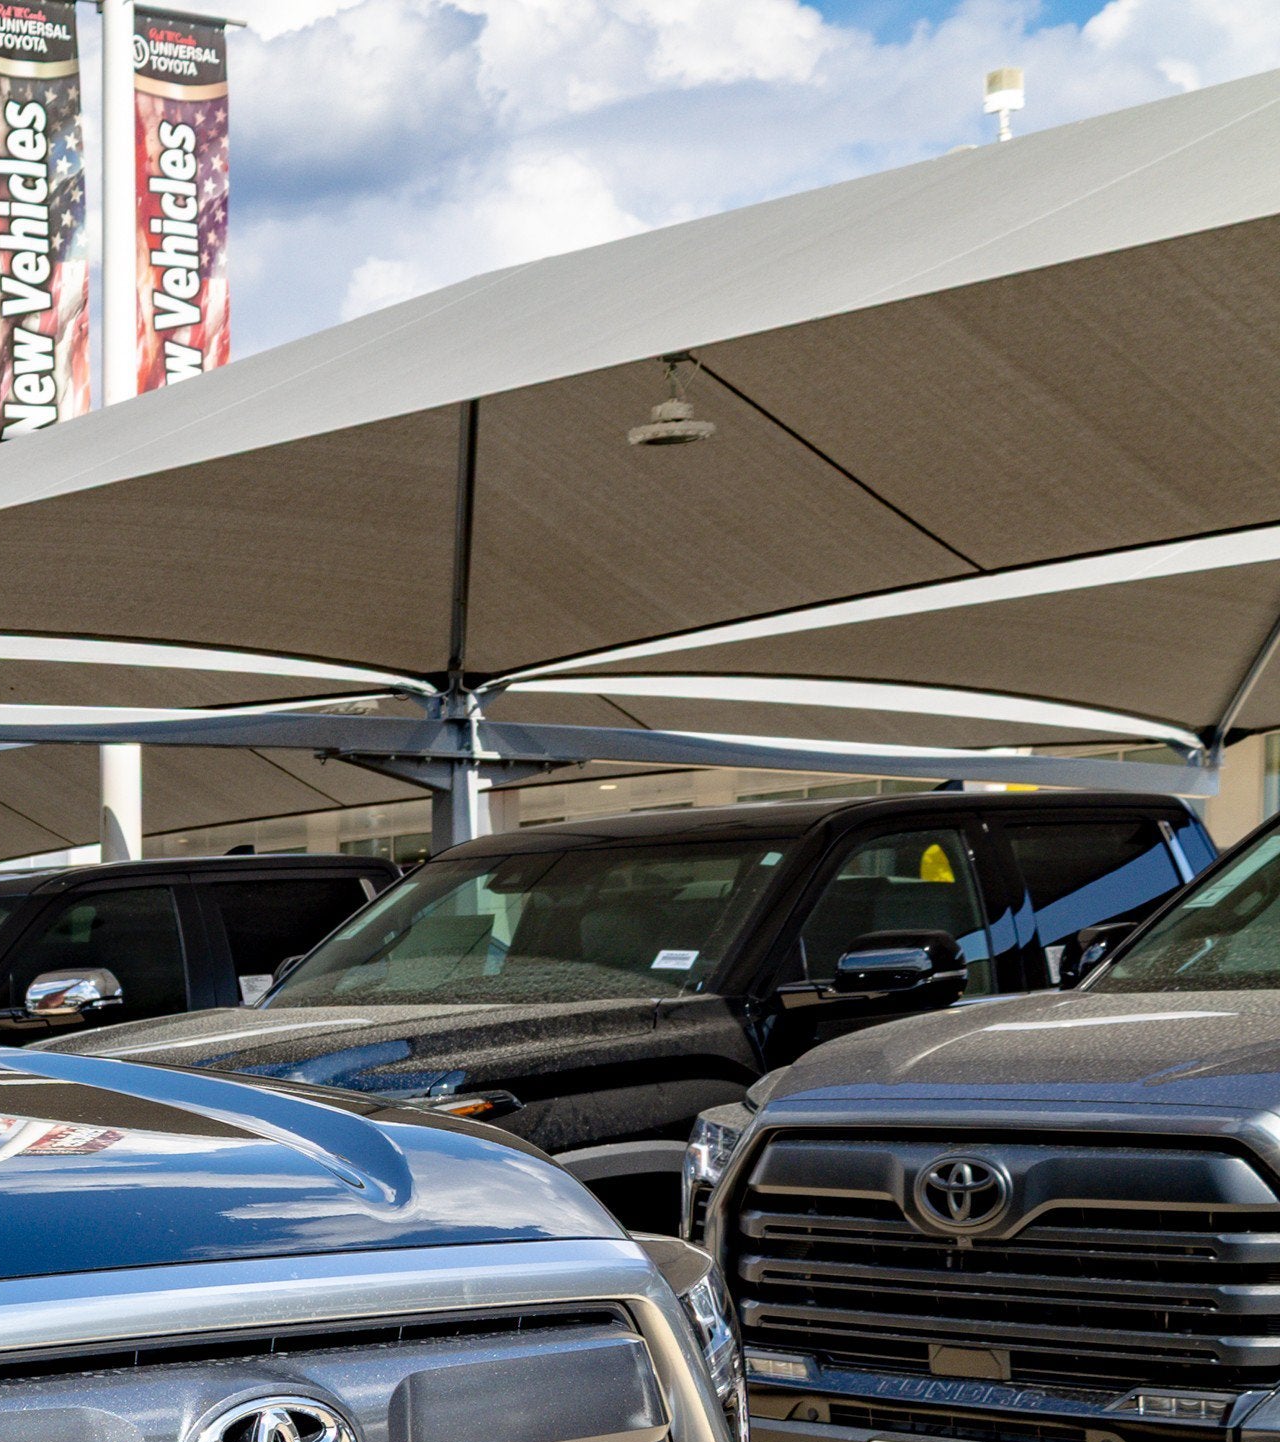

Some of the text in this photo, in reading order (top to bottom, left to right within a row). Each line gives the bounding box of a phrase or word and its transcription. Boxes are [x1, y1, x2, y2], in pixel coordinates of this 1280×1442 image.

[149, 40, 220, 64] UNIVERSAL
[150, 55, 198, 76] TOYOTA
[149, 121, 202, 331] Vehicles
